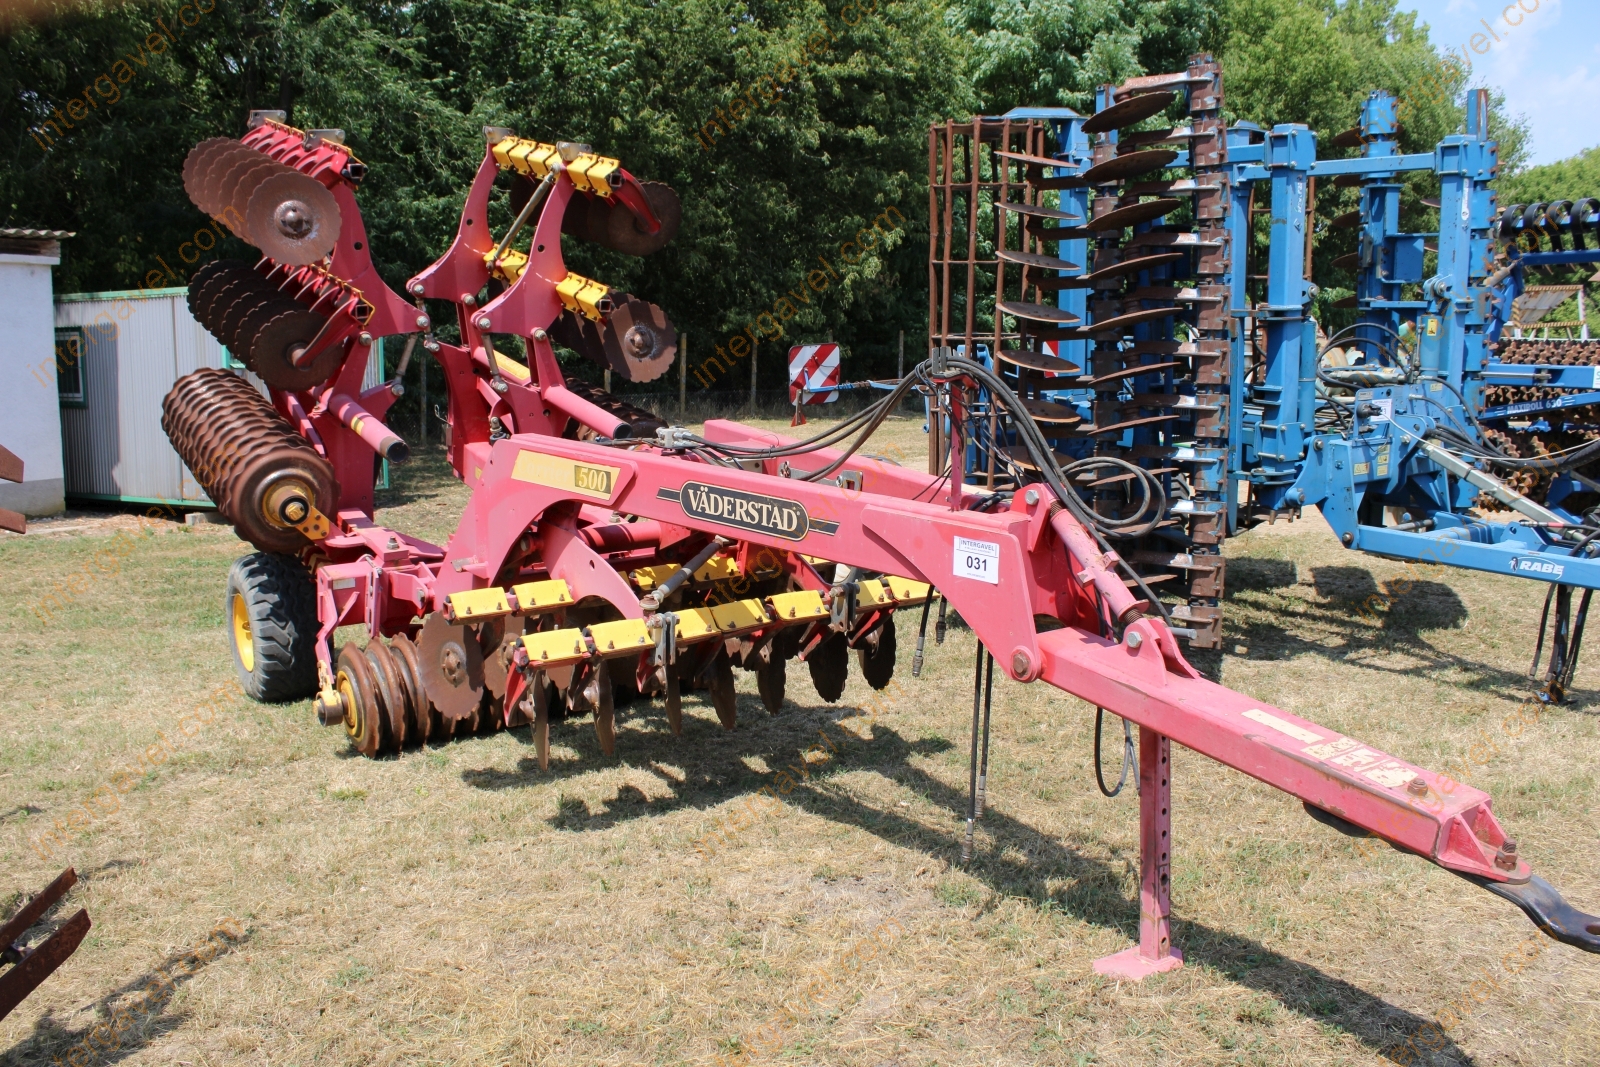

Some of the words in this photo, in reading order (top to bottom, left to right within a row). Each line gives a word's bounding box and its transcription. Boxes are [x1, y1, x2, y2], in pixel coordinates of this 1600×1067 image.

[1506, 401, 1544, 415] MAXIROLL
[1546, 398, 1562, 409] 630
[578, 467, 607, 492] 500
[688, 485, 799, 532] VÄDERSTAD
[960, 539, 995, 552] INTERGAVEL
[966, 555, 987, 572] 031
[1520, 560, 1565, 575] RABE
